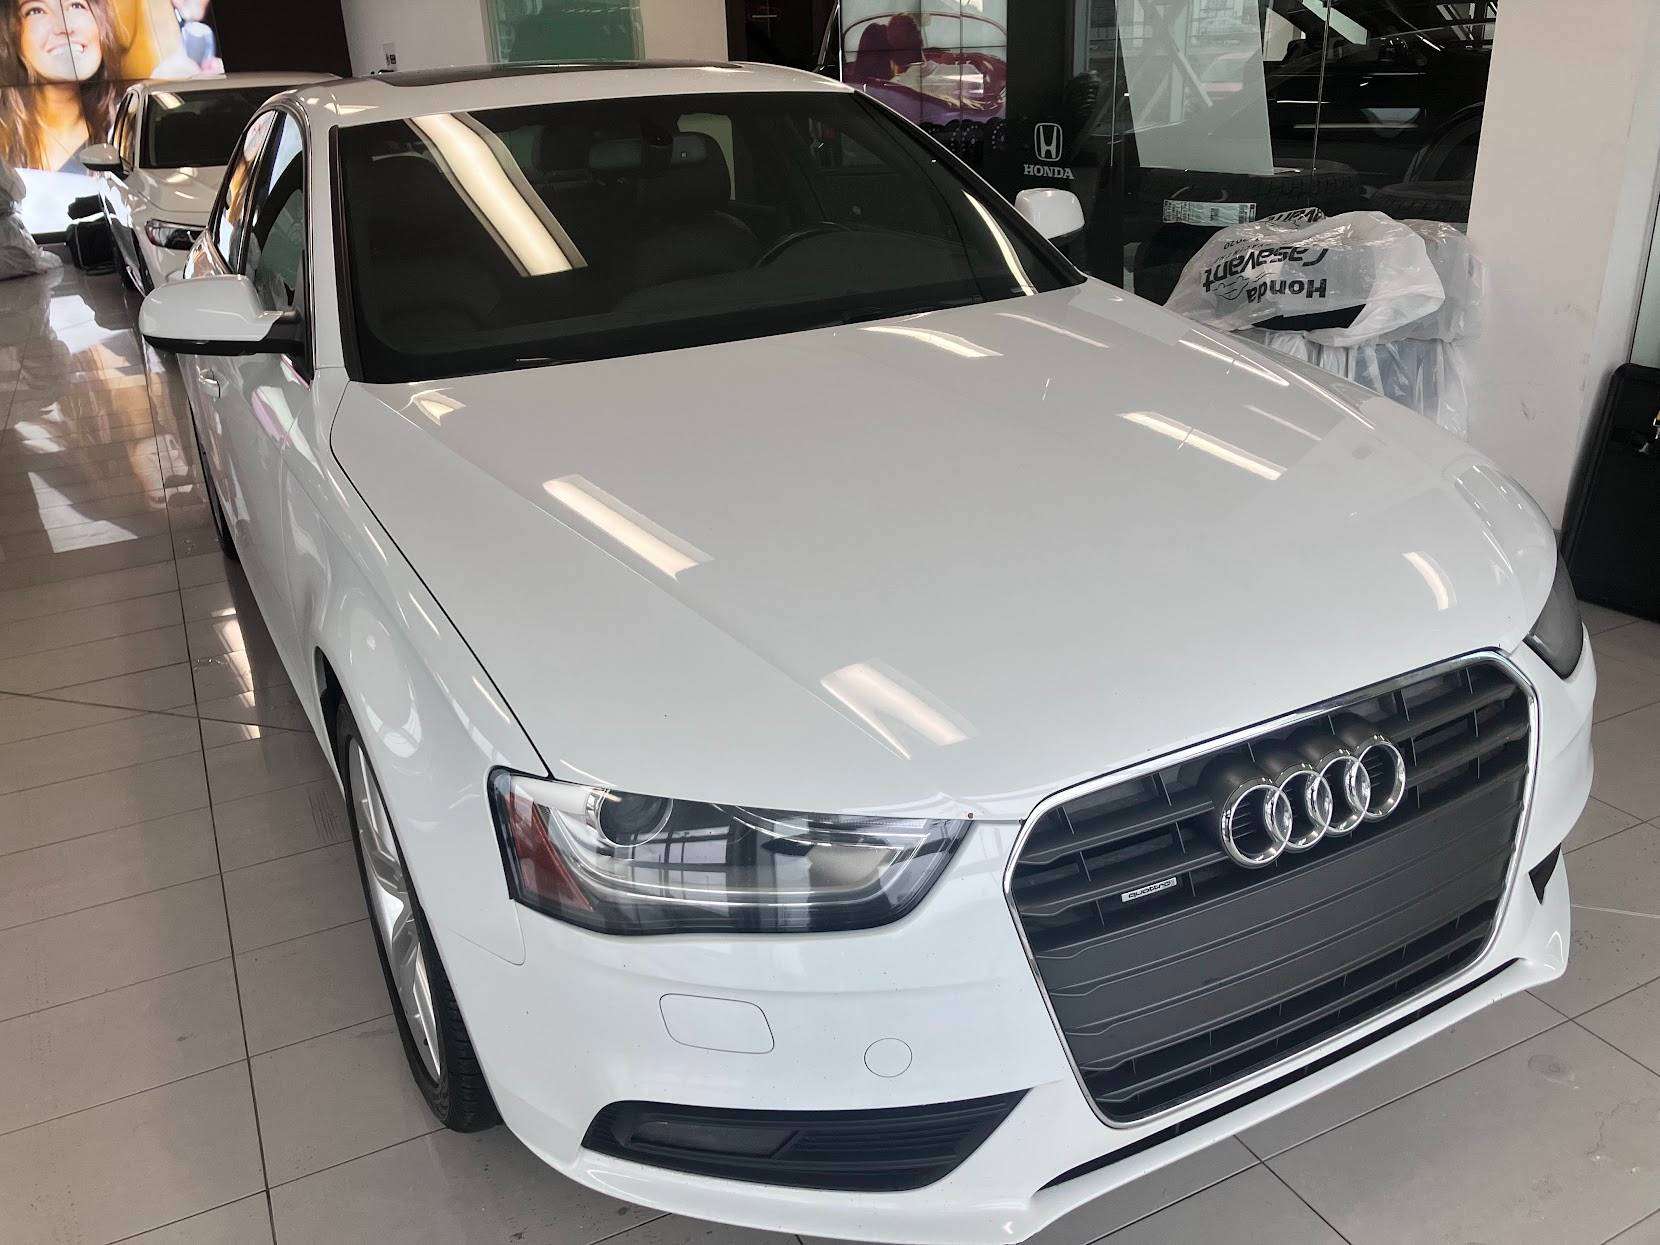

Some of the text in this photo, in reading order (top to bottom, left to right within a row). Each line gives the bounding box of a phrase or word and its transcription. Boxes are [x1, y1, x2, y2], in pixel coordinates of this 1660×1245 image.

[1023, 164, 1075, 180] HONDA
[1246, 278, 1328, 304] Honda
[1128, 880, 1172, 899] quattro
